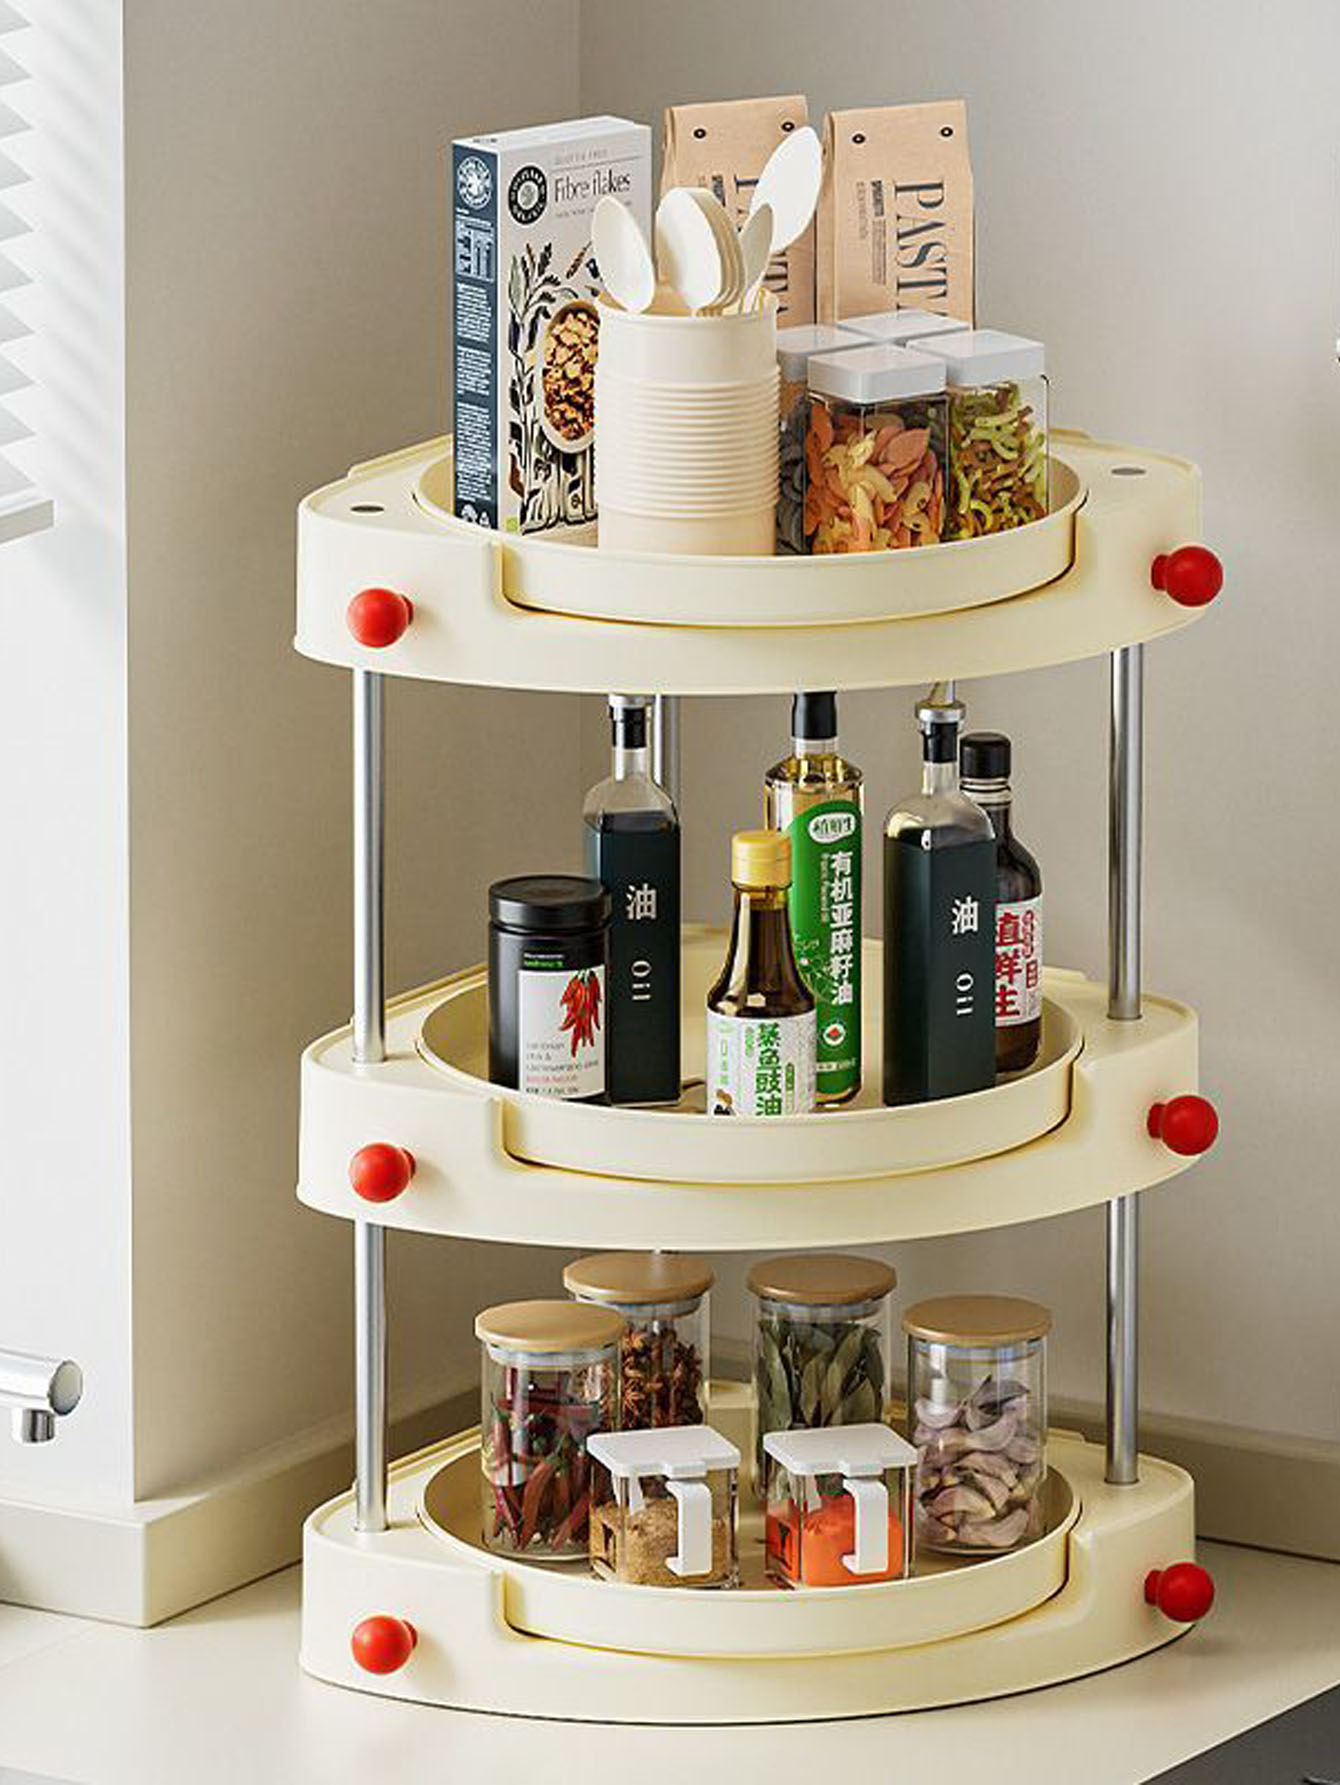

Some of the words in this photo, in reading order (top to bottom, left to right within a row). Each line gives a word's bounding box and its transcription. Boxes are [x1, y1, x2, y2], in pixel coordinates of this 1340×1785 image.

[554, 176, 590, 203] Fibre
[593, 168, 631, 196] flakes
[626, 883, 657, 920] 油
[951, 895, 979, 934] 油
[830, 851, 853, 1004] 有机亚麻籽油
[631, 960, 652, 1000] Oil
[956, 973, 974, 1016] Oil
